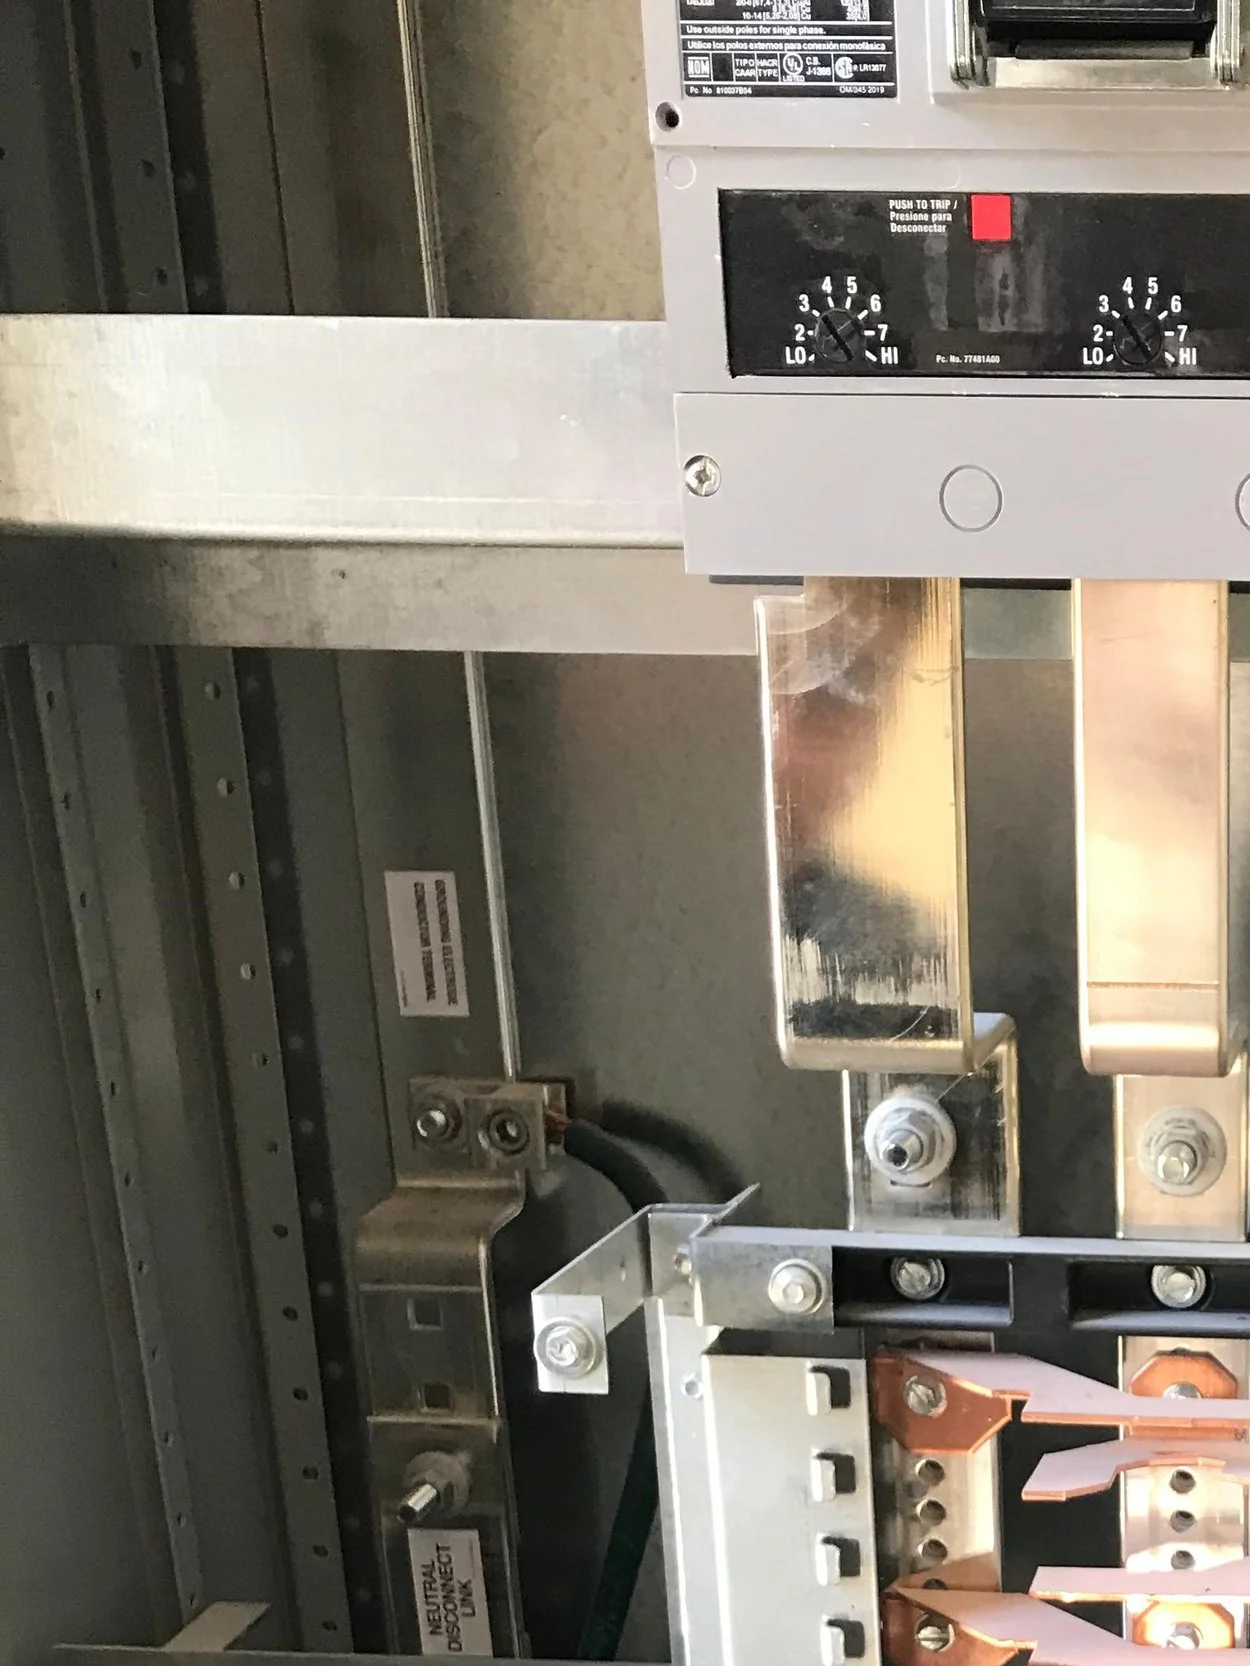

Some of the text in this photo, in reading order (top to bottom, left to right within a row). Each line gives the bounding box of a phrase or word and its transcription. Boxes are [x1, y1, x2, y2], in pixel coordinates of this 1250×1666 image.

[686, 25, 826, 36] Use outside poles for single phase.
[713, 41, 725, 49] los
[726, 41, 748, 51] polos
[784, 43, 801, 52] para
[735, 58, 755, 67] TIPO
[758, 69, 778, 77] TYPE
[889, 199, 913, 210] PUSH
[915, 199, 928, 210] TO
[929, 199, 952, 210] TRIP
[889, 211, 952, 223] Presione para
[890, 223, 947, 233] Desconectar
[822, 276, 832, 294] 4
[846, 276, 858, 294] 5
[1122, 277, 1133, 294] 4
[1147, 277, 1159, 294] 5
[799, 295, 810, 311] 3
[870, 295, 881, 311] 6
[1099, 296, 1109, 312] 3
[1171, 296, 1181, 312] 6
[794, 325, 804, 341] 2
[878, 325, 887, 341] 7
[1093, 325, 1103, 342] 2
[1178, 325, 1188, 342] 7
[785, 347, 806, 364] LO
[881, 347, 899, 364] HI
[936, 354, 948, 363] Pc.
[949, 354, 962, 363] No.
[1083, 348, 1104, 365] LO
[1179, 348, 1197, 365] HI
[421, 1560, 443, 1635] NEUTRAL
[435, 1542, 462, 1652] DISCONNECT
[457, 1579, 475, 1617] LINK
